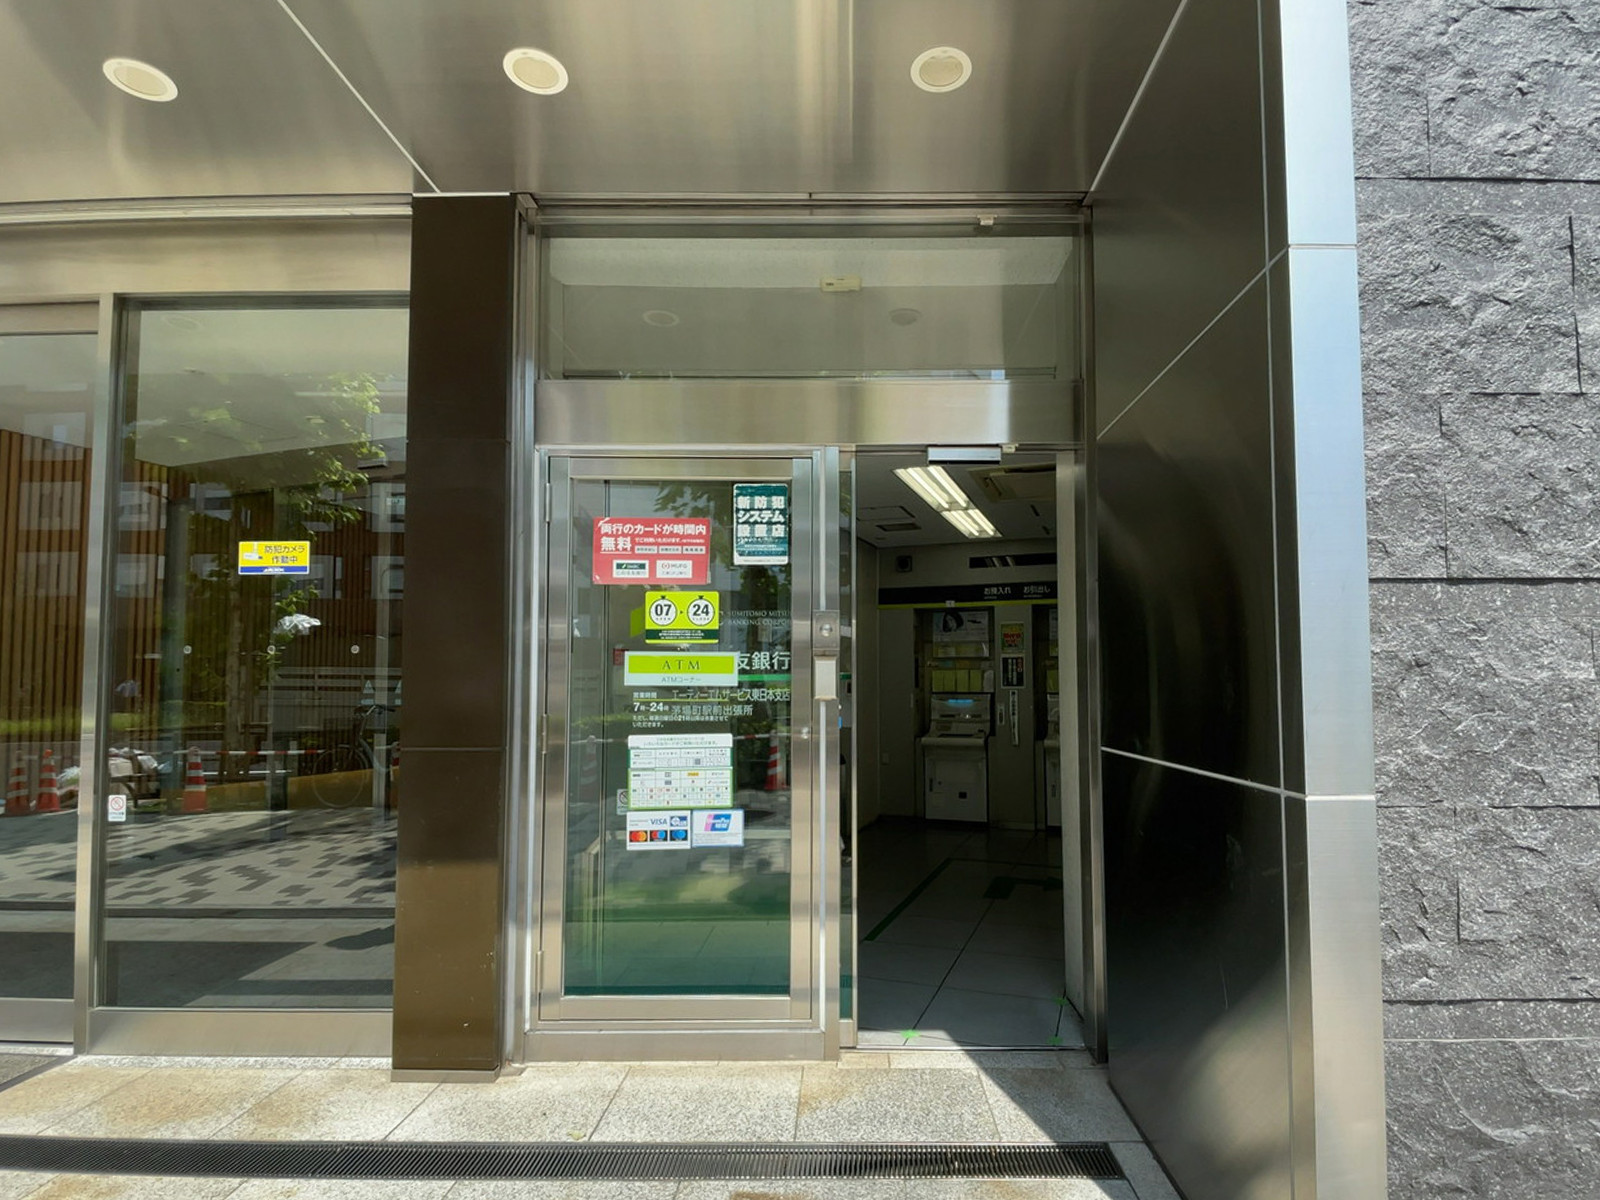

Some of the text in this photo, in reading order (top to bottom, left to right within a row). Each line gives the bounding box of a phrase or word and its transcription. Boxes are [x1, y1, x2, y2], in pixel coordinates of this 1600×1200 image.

[736, 495, 786, 509] 新防犯
[737, 510, 786, 523] システム
[600, 523, 707, 535] 両行のカードが時間内
[264, 545, 305, 554] 防犯カメラ
[601, 536, 632, 552] 無料
[272, 555, 298, 564] 作動中
[654, 604, 710, 616] 07 24
[661, 660, 701, 671] ATM
